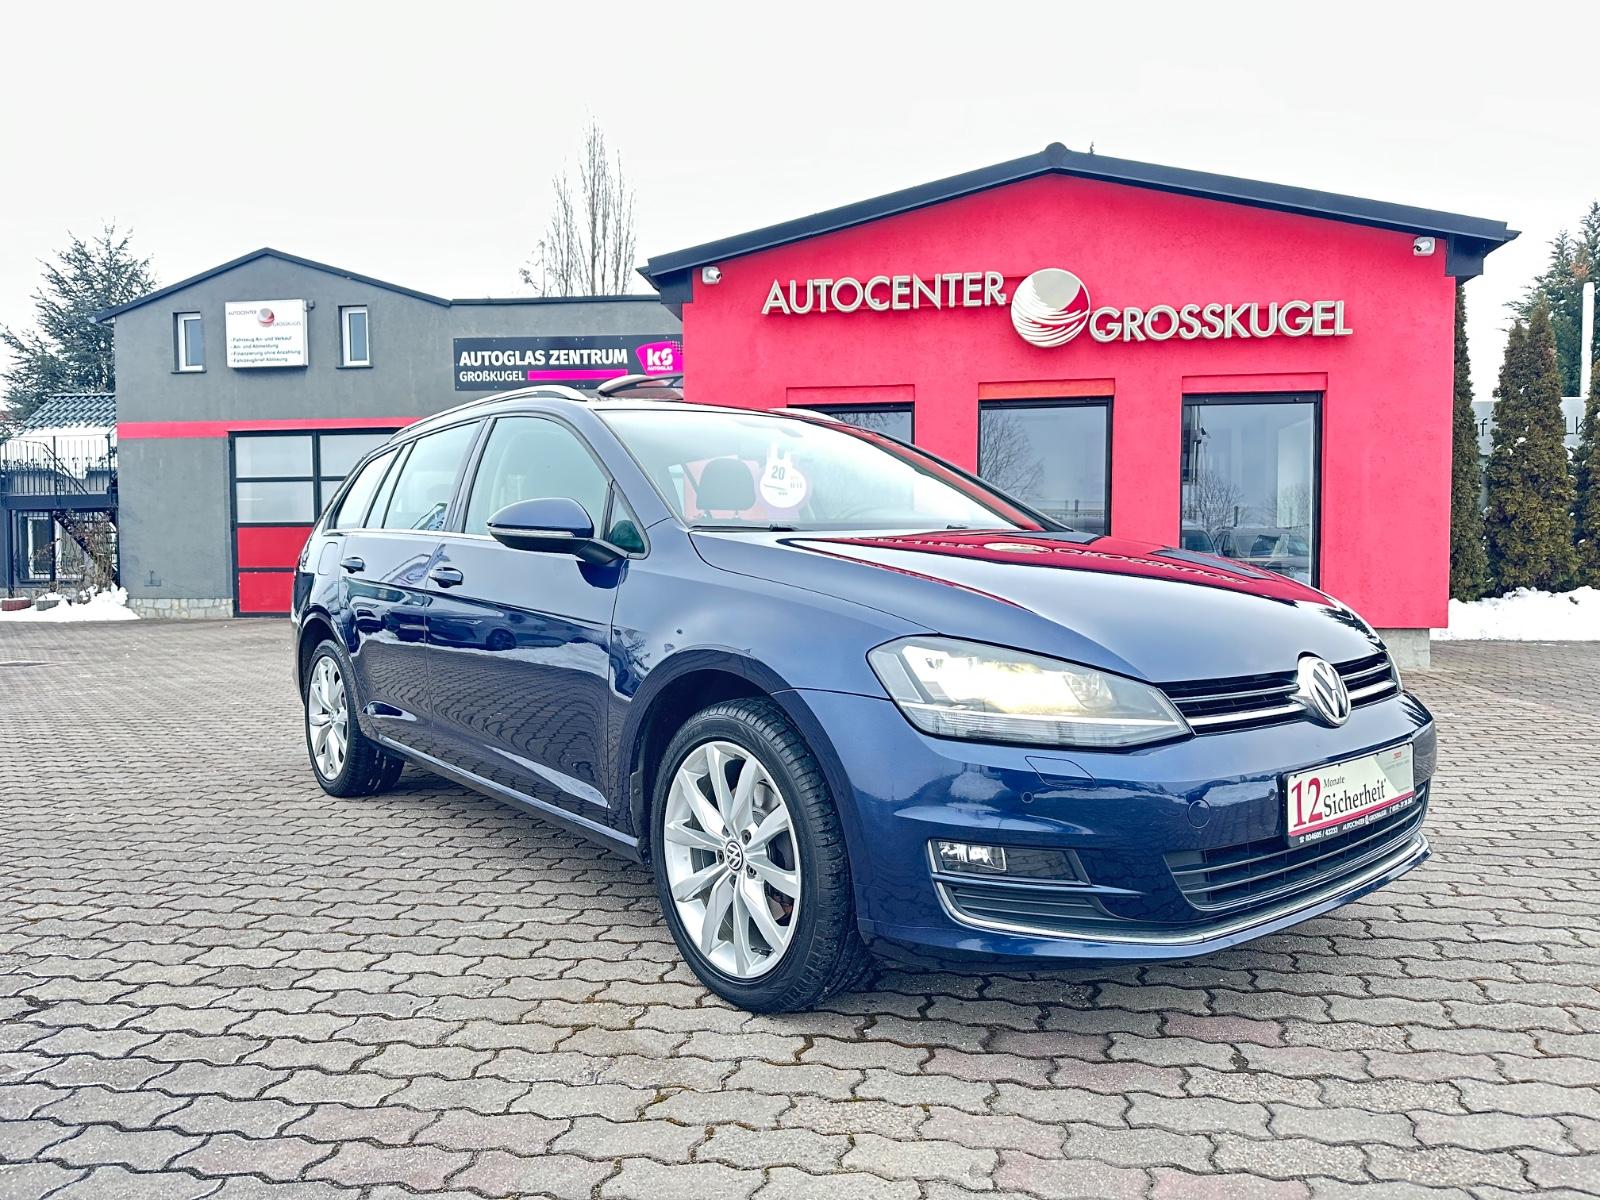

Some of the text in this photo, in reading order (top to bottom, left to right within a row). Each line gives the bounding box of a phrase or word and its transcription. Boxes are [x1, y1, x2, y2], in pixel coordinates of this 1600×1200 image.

[761, 271, 1353, 343] AUTOCENTER GROSSKUGEL
[459, 348, 628, 366] AUTOGLAS ZENTRUM
[459, 370, 525, 382] GROßKUGEL
[771, 465, 785, 480] 20
[1323, 775, 1345, 789] Monate
[1291, 777, 1323, 828] 12
